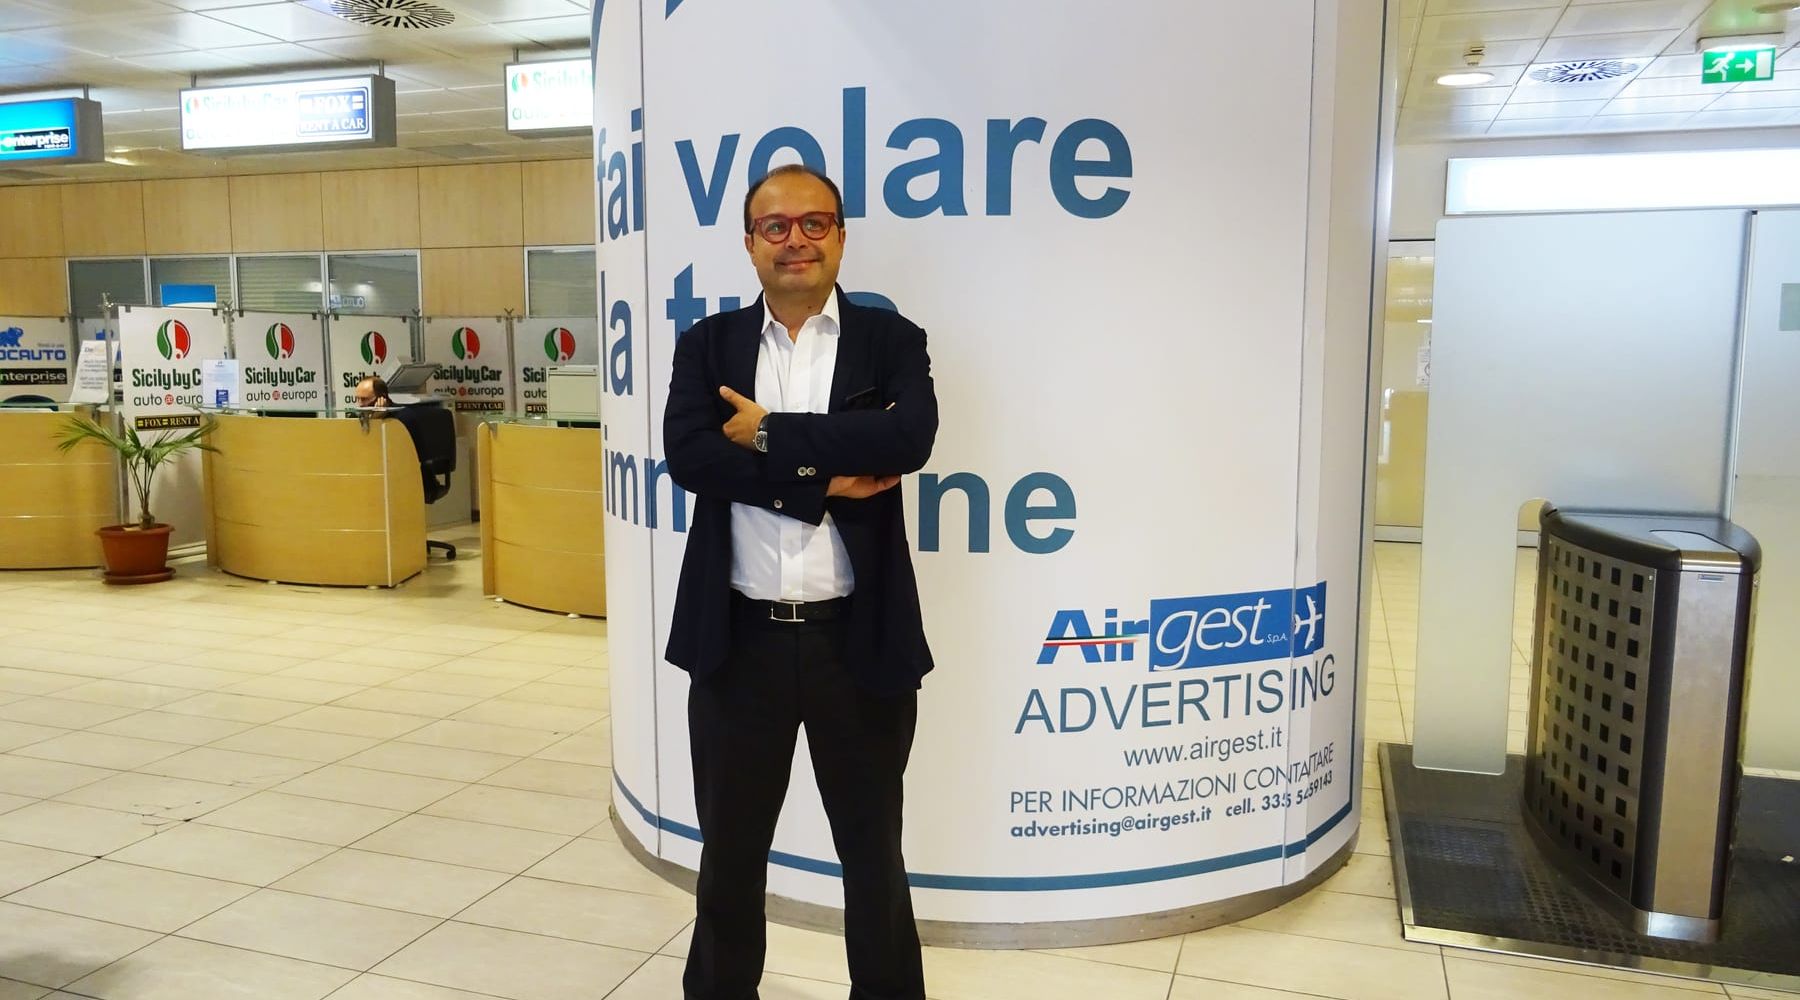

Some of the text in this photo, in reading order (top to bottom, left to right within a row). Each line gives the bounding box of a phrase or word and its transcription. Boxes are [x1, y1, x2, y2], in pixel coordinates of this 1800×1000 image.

[342, 117, 365, 129] CAR
[597, 86, 1133, 243] fai volare
[602, 271, 633, 396] la
[0, 349, 66, 361] OCAUTO
[0, 371, 66, 383] nterprise
[133, 393, 203, 406] auto euro
[246, 390, 318, 402] auto europa
[467, 386, 504, 398] europa
[1014, 654, 1335, 734] ADVERTISING
[1123, 726, 1282, 767] www.airgest.it
[1010, 791, 1052, 813] PER
[1062, 772, 1236, 812] INFORMAZIONI
[1010, 807, 1212, 838] advertising@airgest.it
[1225, 797, 1256, 817] cell.
